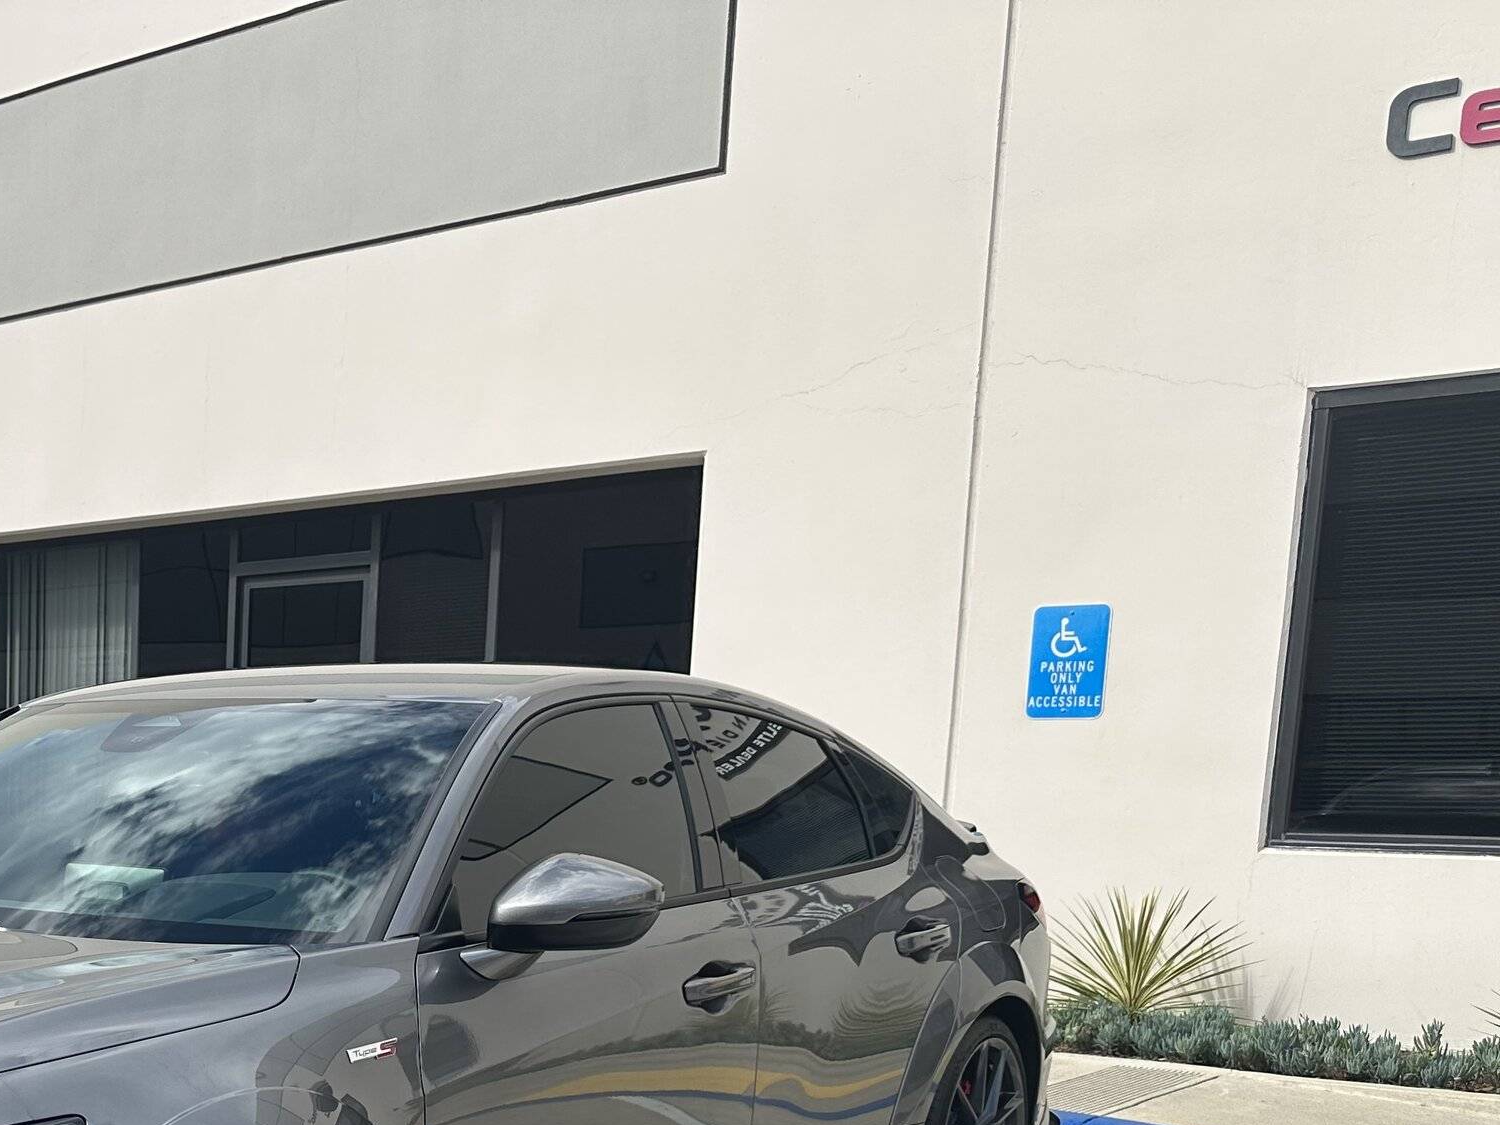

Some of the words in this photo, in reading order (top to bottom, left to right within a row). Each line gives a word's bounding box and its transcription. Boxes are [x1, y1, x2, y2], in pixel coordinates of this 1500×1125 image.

[1040, 660, 1095, 673] PARKING
[1050, 672, 1083, 684] ONLY
[1053, 684, 1077, 695] VAN
[1028, 695, 1101, 708] ACCESSIBLE
